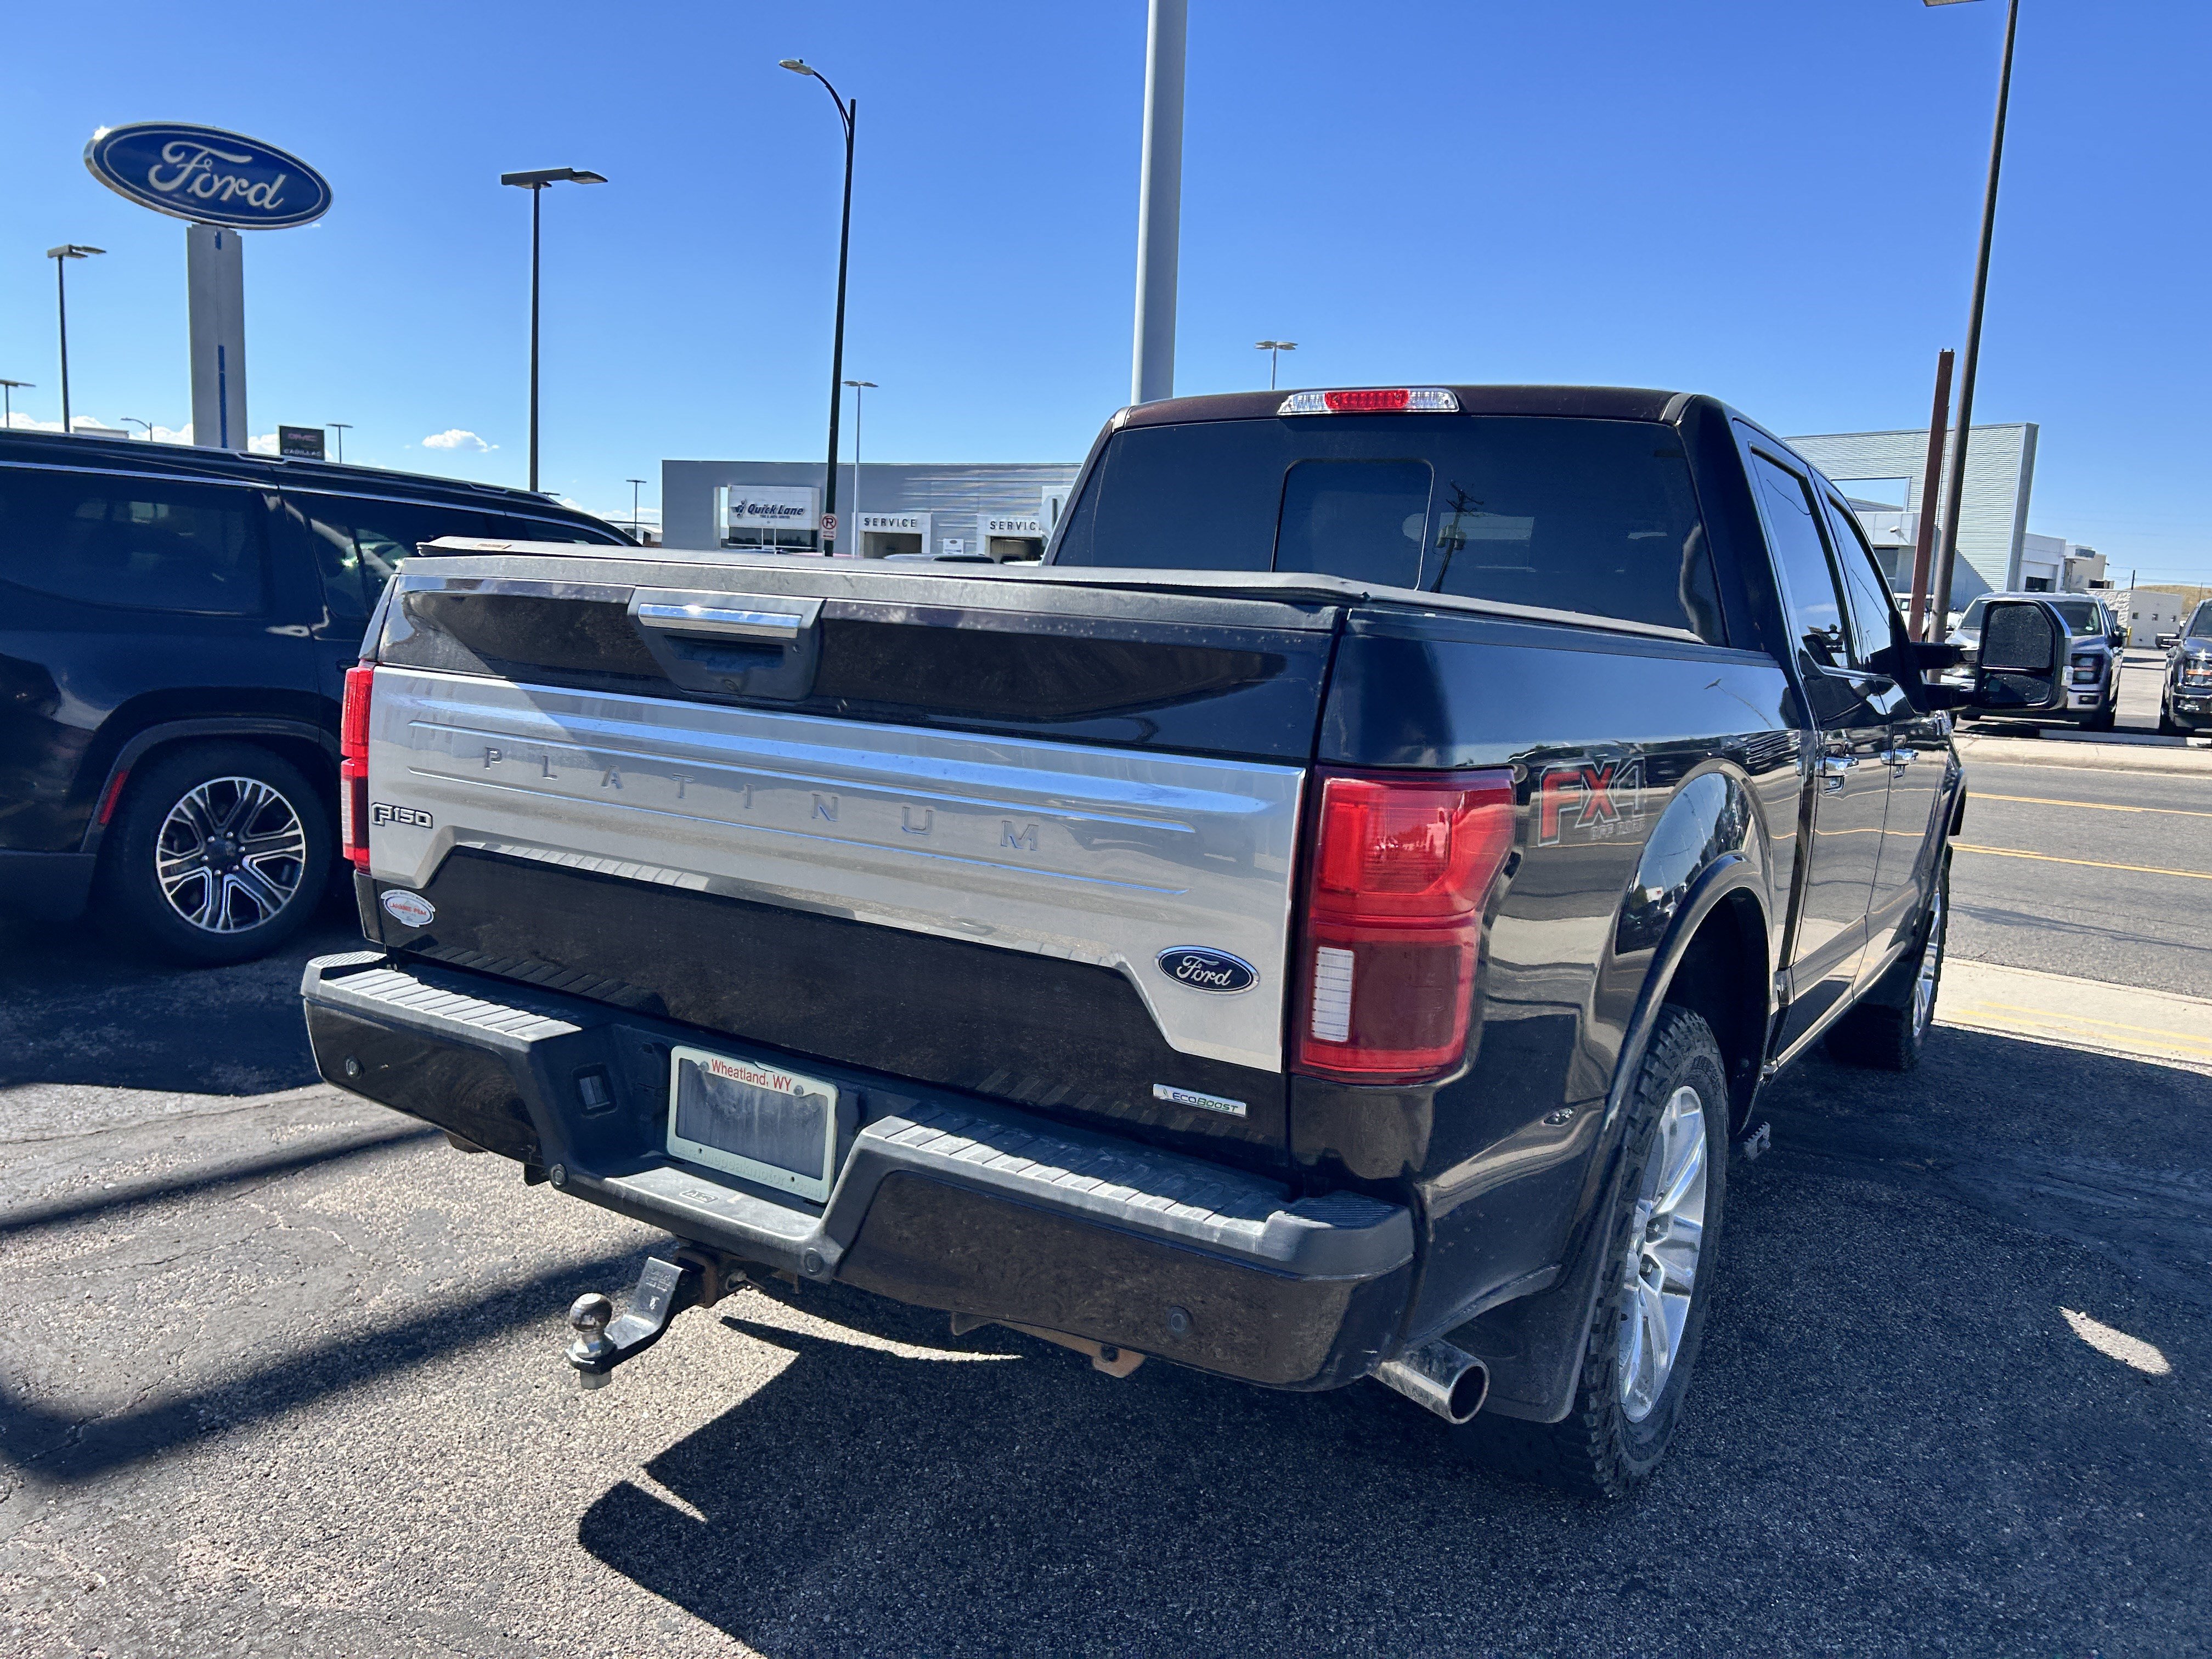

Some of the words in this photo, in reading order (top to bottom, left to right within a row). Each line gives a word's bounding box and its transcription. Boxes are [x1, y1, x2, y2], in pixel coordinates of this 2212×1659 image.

[148, 141, 286, 210] Ford
[283, 448, 323, 457] CADILLAC
[747, 504, 776, 515] Quick
[777, 504, 805, 516] Lane
[864, 517, 917, 527] SERVICE
[990, 521, 1042, 531] SERVIC
[484, 746, 1039, 851] PLATINUM
[1538, 757, 1645, 847] FX4
[1176, 955, 1232, 986] Ford
[712, 1058, 769, 1087] Wheatland,
[773, 1074, 792, 1092] WY
